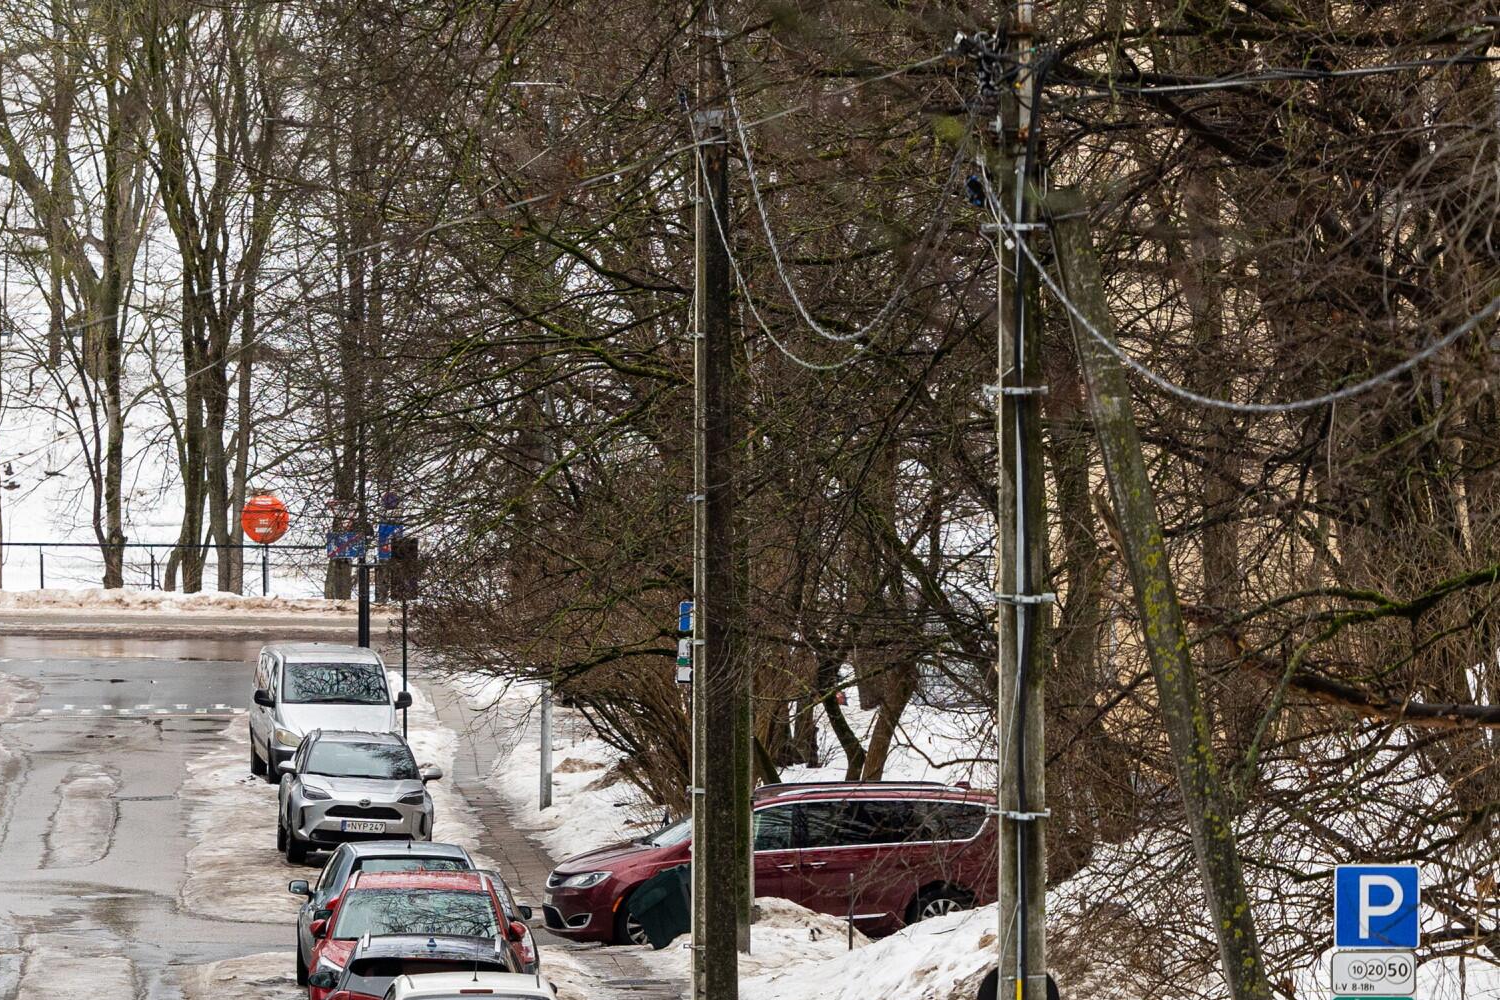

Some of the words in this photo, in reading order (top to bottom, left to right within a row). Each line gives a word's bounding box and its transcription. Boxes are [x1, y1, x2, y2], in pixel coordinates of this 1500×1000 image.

[369, 823, 384, 831] 247
[1359, 874, 1404, 939] P
[1352, 965, 1363, 975] 10
[1368, 964, 1383, 976] 20
[1388, 963, 1408, 977] 50
[1351, 983, 1375, 991] 8-18h
